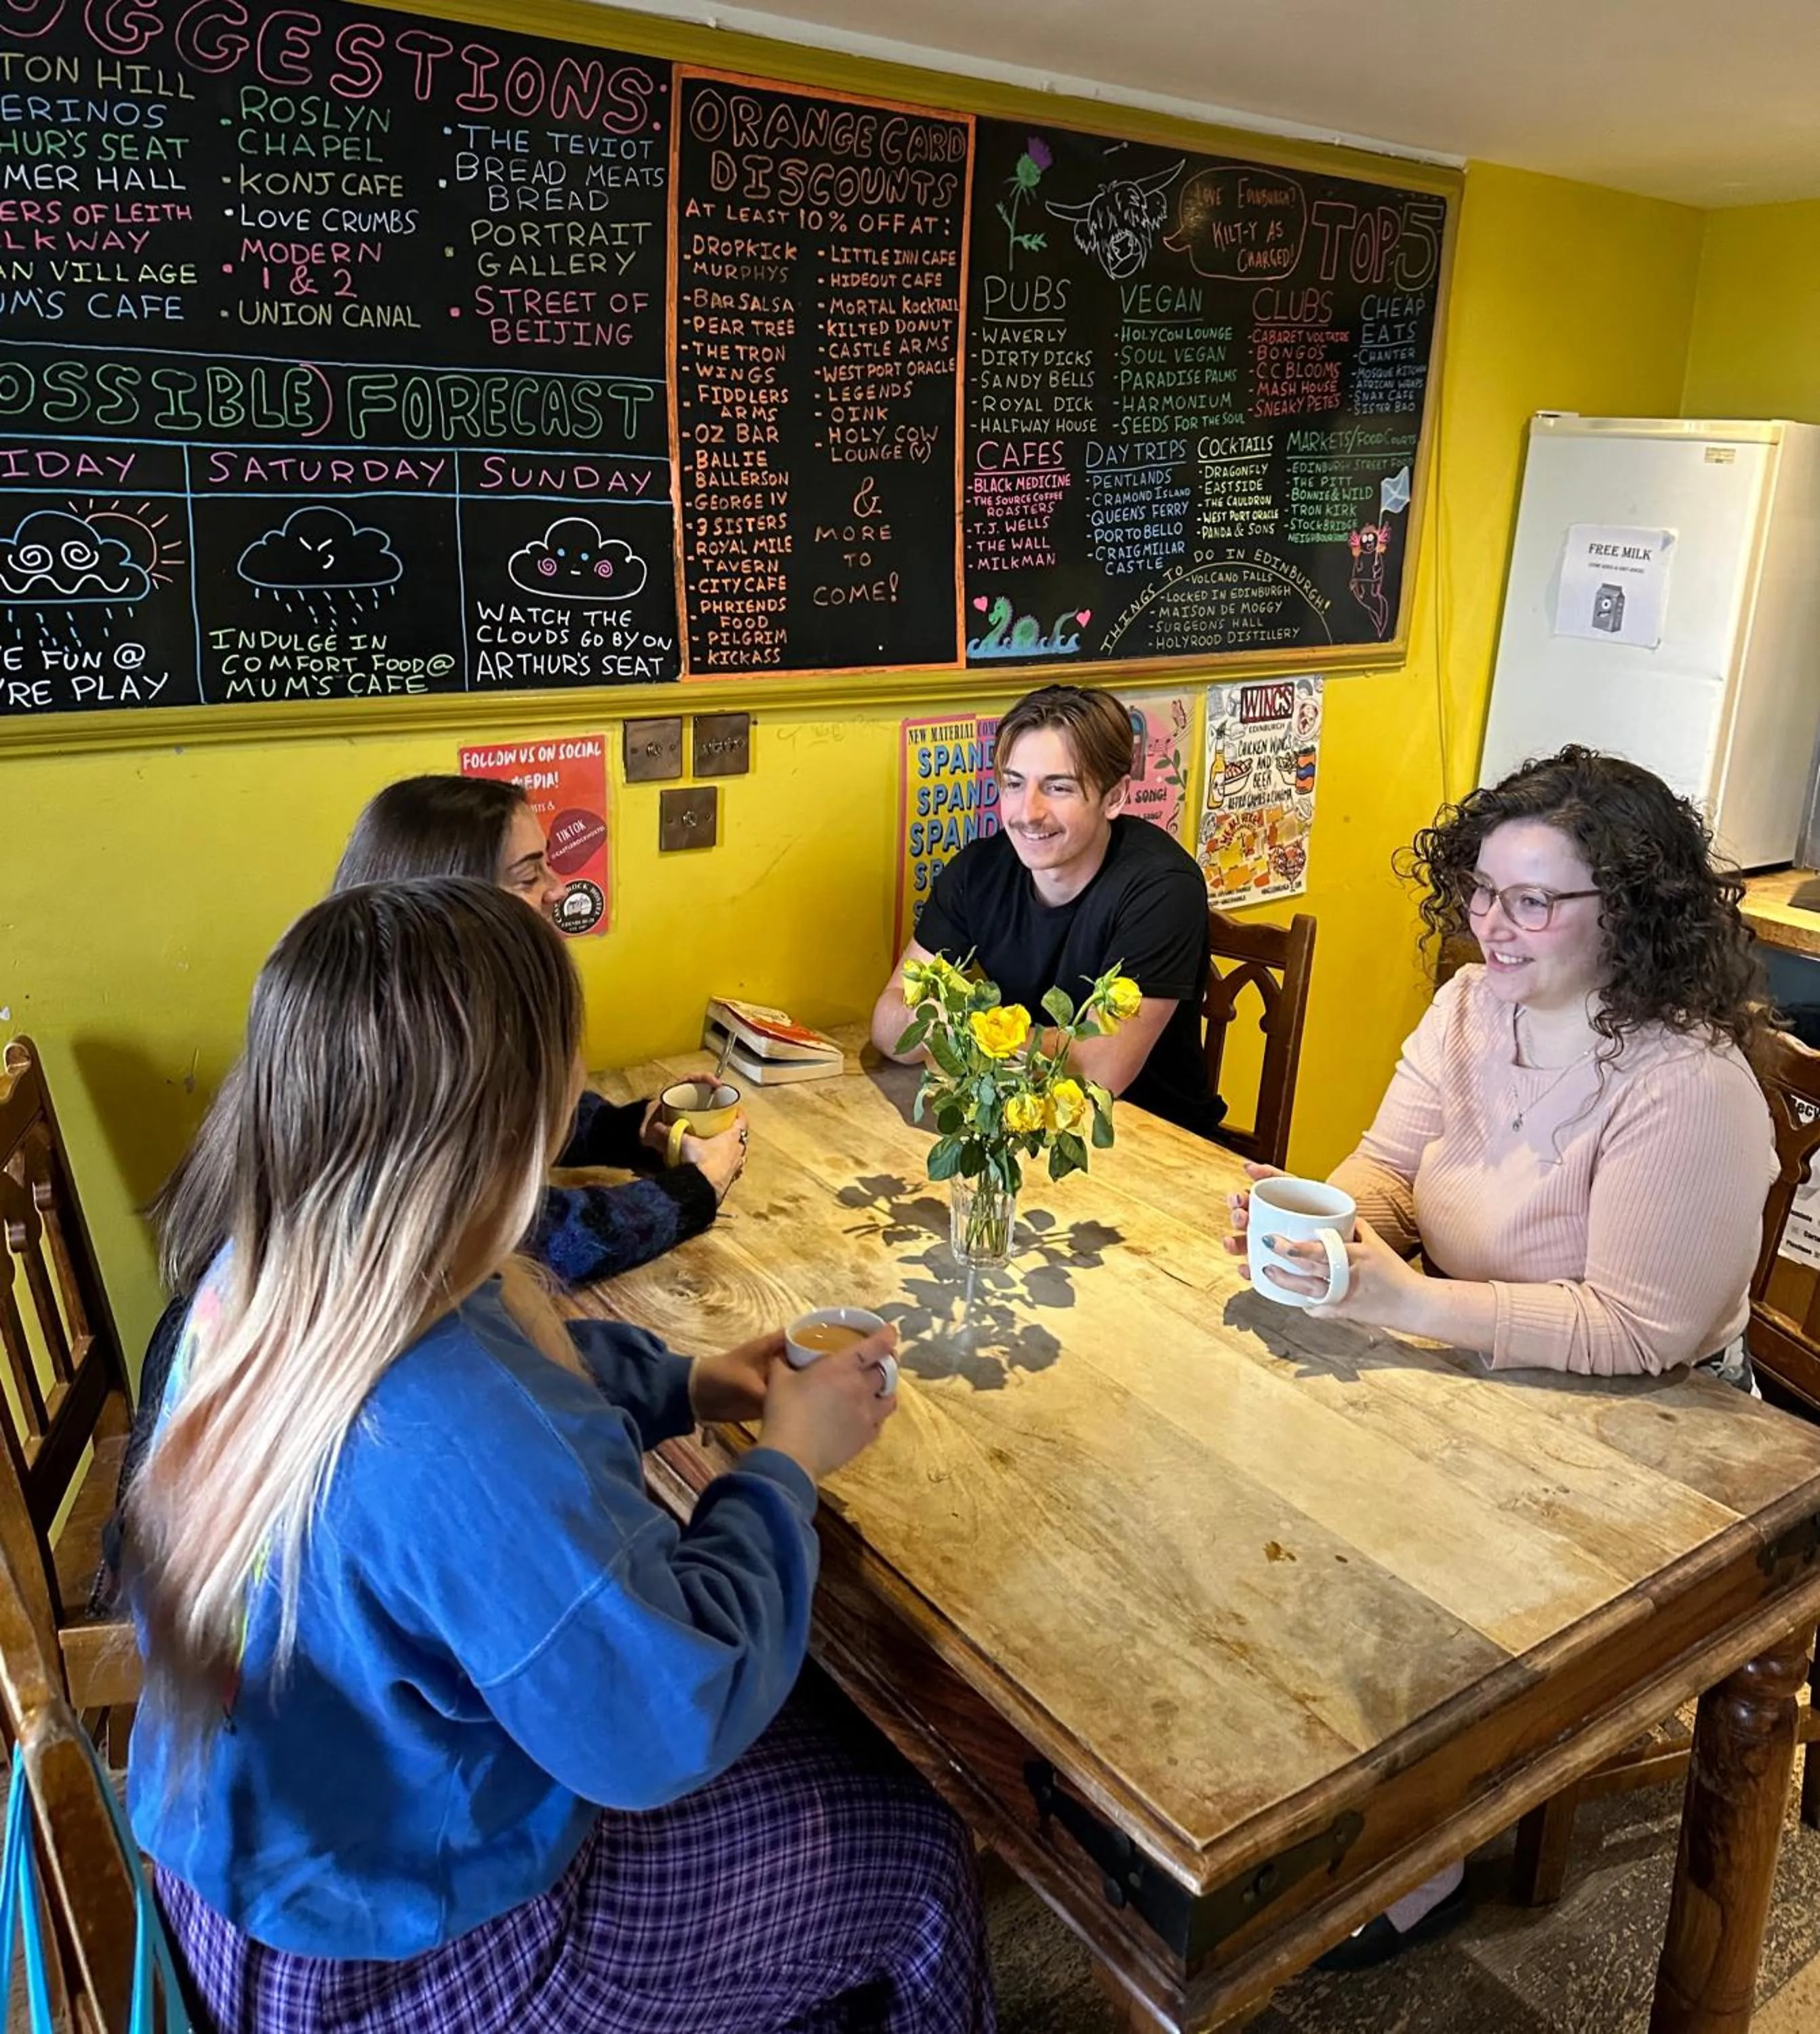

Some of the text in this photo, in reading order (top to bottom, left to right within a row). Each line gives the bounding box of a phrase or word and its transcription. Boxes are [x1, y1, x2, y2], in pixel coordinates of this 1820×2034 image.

[98, 59, 195, 100] HILL
[240, 86, 390, 133] ROSLYN
[690, 88, 966, 165] ORANGE CARD
[238, 129, 382, 163] CHAPEL
[458, 123, 654, 160] THE TEVIOT
[97, 167, 186, 191] HALL
[240, 163, 404, 197] KONJ CAFE
[456, 152, 665, 188] BREAD MEATS
[711, 150, 958, 208] DISCOUNTS
[241, 204, 419, 234] LOVE CRUMBS
[686, 198, 716, 218] AT
[727, 203, 790, 225] LEAST
[799, 208, 848, 233] 10%
[471, 219, 652, 247] PORTRAIT
[240, 239, 381, 264] MODERN
[692, 235, 797, 260] DROPKICK
[831, 245, 957, 266] LITTLE INN CAFE
[1313, 201, 1444, 291] TOP 5
[50, 261, 198, 285] VILLAGE
[478, 251, 636, 277] GALLERY
[693, 262, 789, 283] MURPHYS
[831, 273, 942, 288] HIDEOUT CAFE
[475, 285, 597, 317] STREET
[985, 275, 1071, 315] PUBS
[1120, 284, 1202, 313] VEGAN
[1252, 287, 1333, 323] CLUBS
[239, 300, 421, 328] UNION CANAL
[830, 297, 896, 316] MORTAL
[1360, 294, 1425, 321] CHEAP
[491, 319, 633, 347] BEIJING
[693, 316, 795, 336] PEAR TREE
[827, 318, 953, 338] KILTED DONUT
[982, 327, 1067, 344] WAVERLY
[1362, 321, 1418, 344] EATS
[692, 342, 786, 362] THE TRON
[829, 336, 949, 359] CASTLE ARMS
[982, 349, 1093, 367] DIRTY DICKS
[1120, 345, 1227, 365] SOUL VEGAN
[1358, 347, 1415, 365] CHANTER
[696, 362, 776, 384] WINGS
[823, 357, 955, 382] WEST PORT ORACLE
[981, 371, 1095, 389] SANDY BELLS
[1121, 369, 1237, 391] PARADISE PALMS
[698, 384, 789, 404] FIDDLERS
[828, 380, 913, 402] LEGENDS
[1257, 380, 1338, 397] MASH HOUSE
[347, 373, 654, 440] FORECAST
[983, 395, 1093, 412] ROYAL DICK
[1123, 392, 1232, 412] HARMONIUM
[720, 406, 778, 422] ARMS
[831, 407, 888, 422] OINK
[694, 423, 779, 443] OZ BAR
[829, 425, 938, 443] HOLY COW
[981, 418, 1096, 433] HALFWAY HOUSE
[831, 445, 903, 462] LOUNGE
[976, 441, 1065, 470] CAFES
[1198, 435, 1274, 459] COCKTAILS
[209, 452, 445, 487] SATURDAY
[696, 450, 768, 469] BALLIE
[479, 456, 652, 495] SUNDAY
[696, 471, 789, 488] BALLERSON
[1092, 468, 1172, 489] PENTLANDS
[1204, 463, 1268, 479] DRAGONFLY
[974, 473, 1071, 494] BLACK MEDICINE
[1204, 481, 1263, 494] EASTSIDE
[1292, 477, 1353, 488] THE PITT
[694, 492, 787, 510] GEORGE IV
[854, 476, 882, 518] &
[1291, 504, 1358, 515] TRON KIRK
[696, 513, 787, 536] 3 SISTERS
[815, 525, 892, 542] MORE
[1094, 523, 1183, 542] PORTOBELLO
[696, 536, 792, 555] ROYAL MILE
[1095, 541, 1185, 561] CRAIGMILLAR
[1588, 543, 1652, 561] FREE MILK
[703, 559, 778, 573] TAVERN
[844, 553, 871, 567] TO
[978, 553, 1055, 570] MILKMAN
[1105, 557, 1164, 576] CASTLE
[698, 576, 787, 593] CITY CAFE
[1191, 570, 1273, 584] VOLCANO FALLS
[814, 572, 898, 605] COME!
[477, 601, 633, 628] WATCH THE
[700, 597, 787, 614] PHRIENDS
[720, 616, 768, 629] FOOD
[209, 629, 387, 651] INDULGE IN
[477, 629, 672, 651] CLOUDS GO BY ON
[708, 629, 787, 645] PILGRIM
[477, 650, 665, 682] ARTHUR'S SEAT
[708, 648, 780, 665] KICKASS
[226, 674, 429, 698] MUM'S CAFE
[1242, 686, 1293, 719] WINGS
[909, 723, 974, 746] NEW MATERIAL
[462, 741, 601, 770] FOLLOW US ON SOCIAL
[556, 820, 586, 843] TIKTOK
